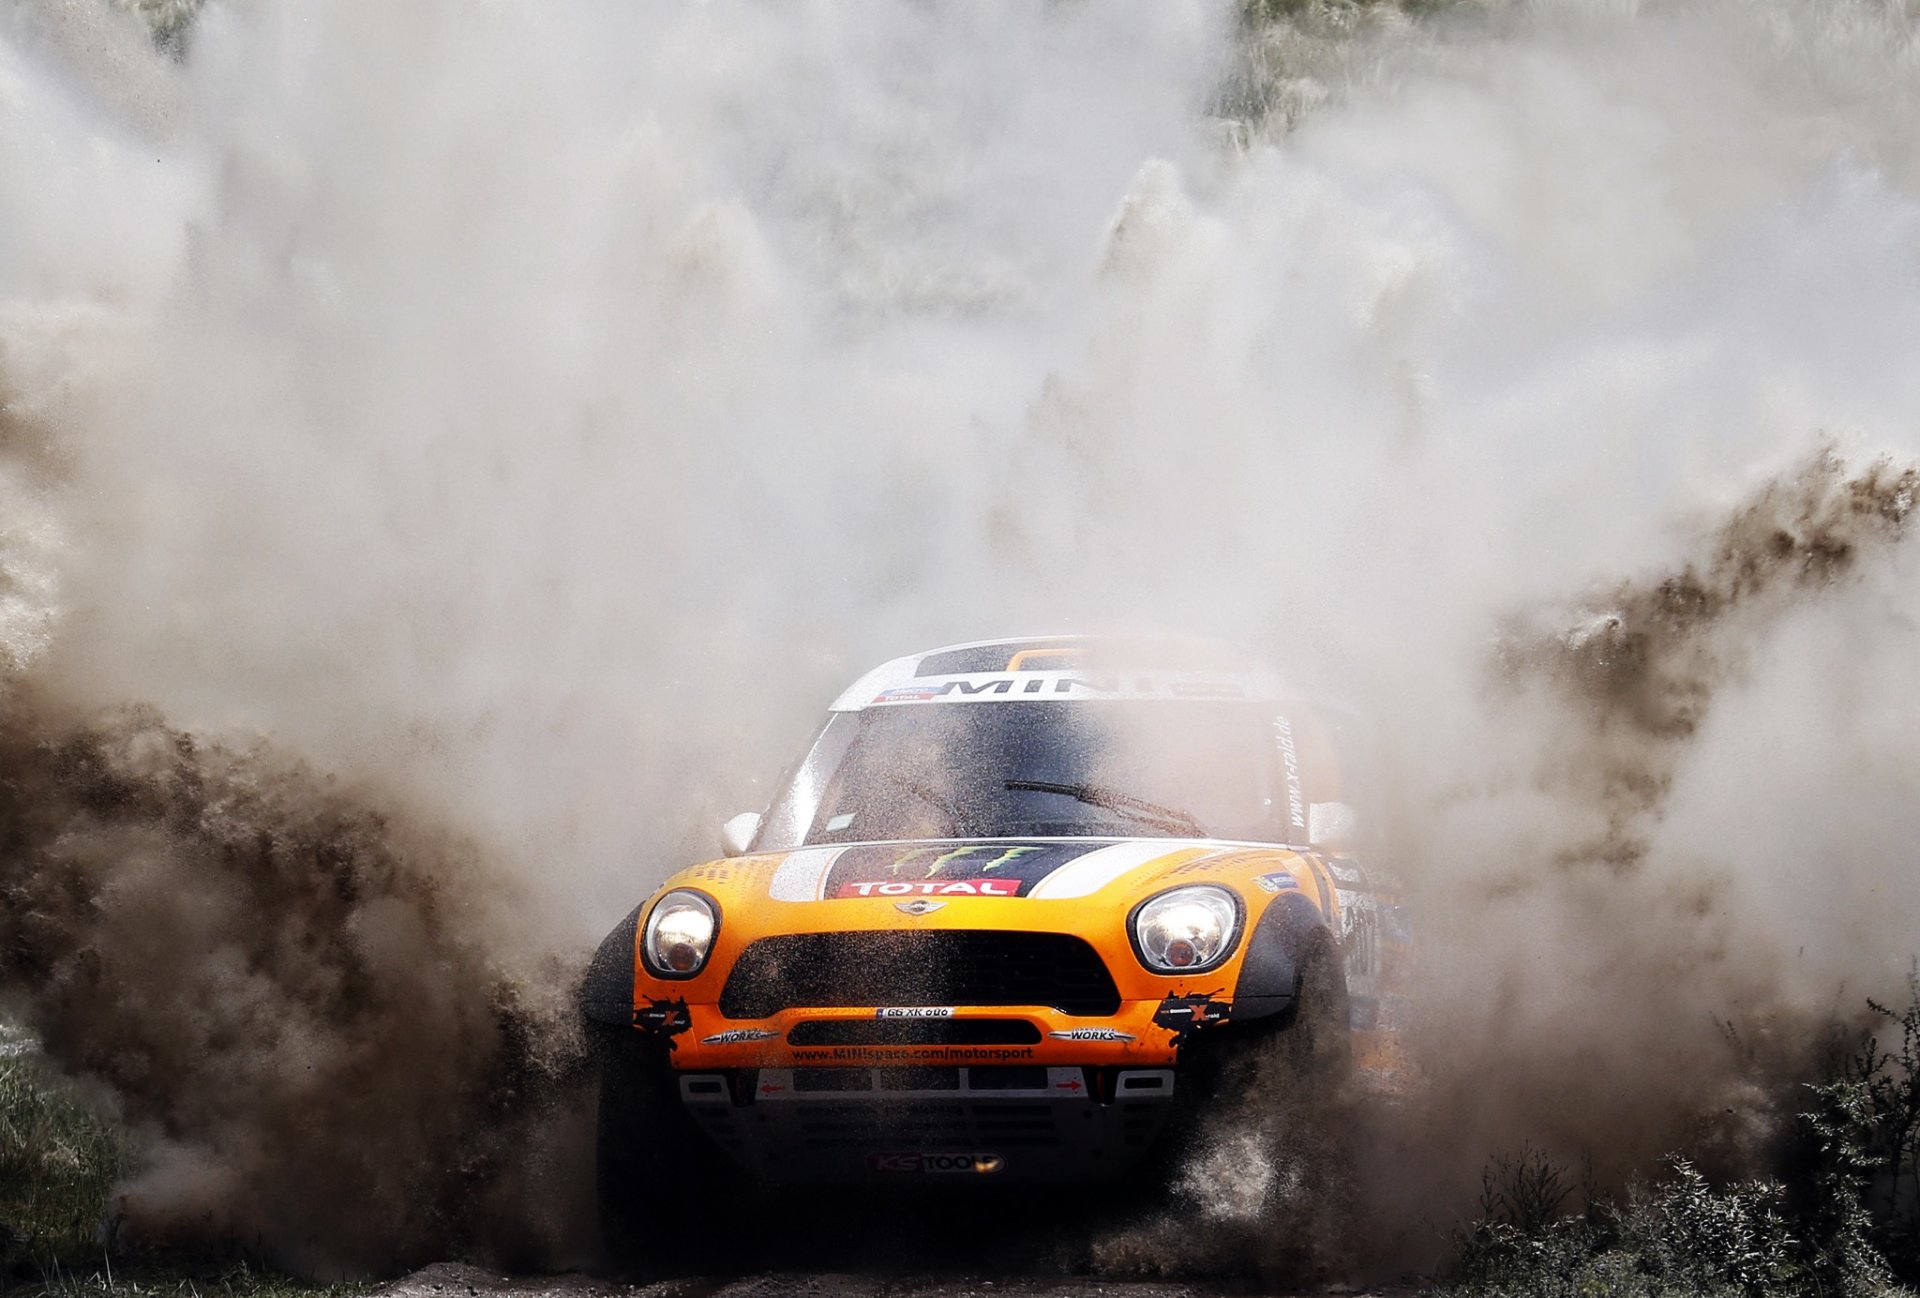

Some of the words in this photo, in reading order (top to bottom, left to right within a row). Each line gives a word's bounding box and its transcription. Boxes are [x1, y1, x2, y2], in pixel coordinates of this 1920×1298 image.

[934, 677, 1151, 695] MINI
[1273, 716, 1304, 827] www.x-raid.de
[851, 881, 1008, 896] TOTAL
[887, 1008, 904, 1017] GG
[720, 1031, 762, 1043] WORKS
[1071, 1031, 1115, 1041] WORKS
[877, 1155, 920, 1170] KS
